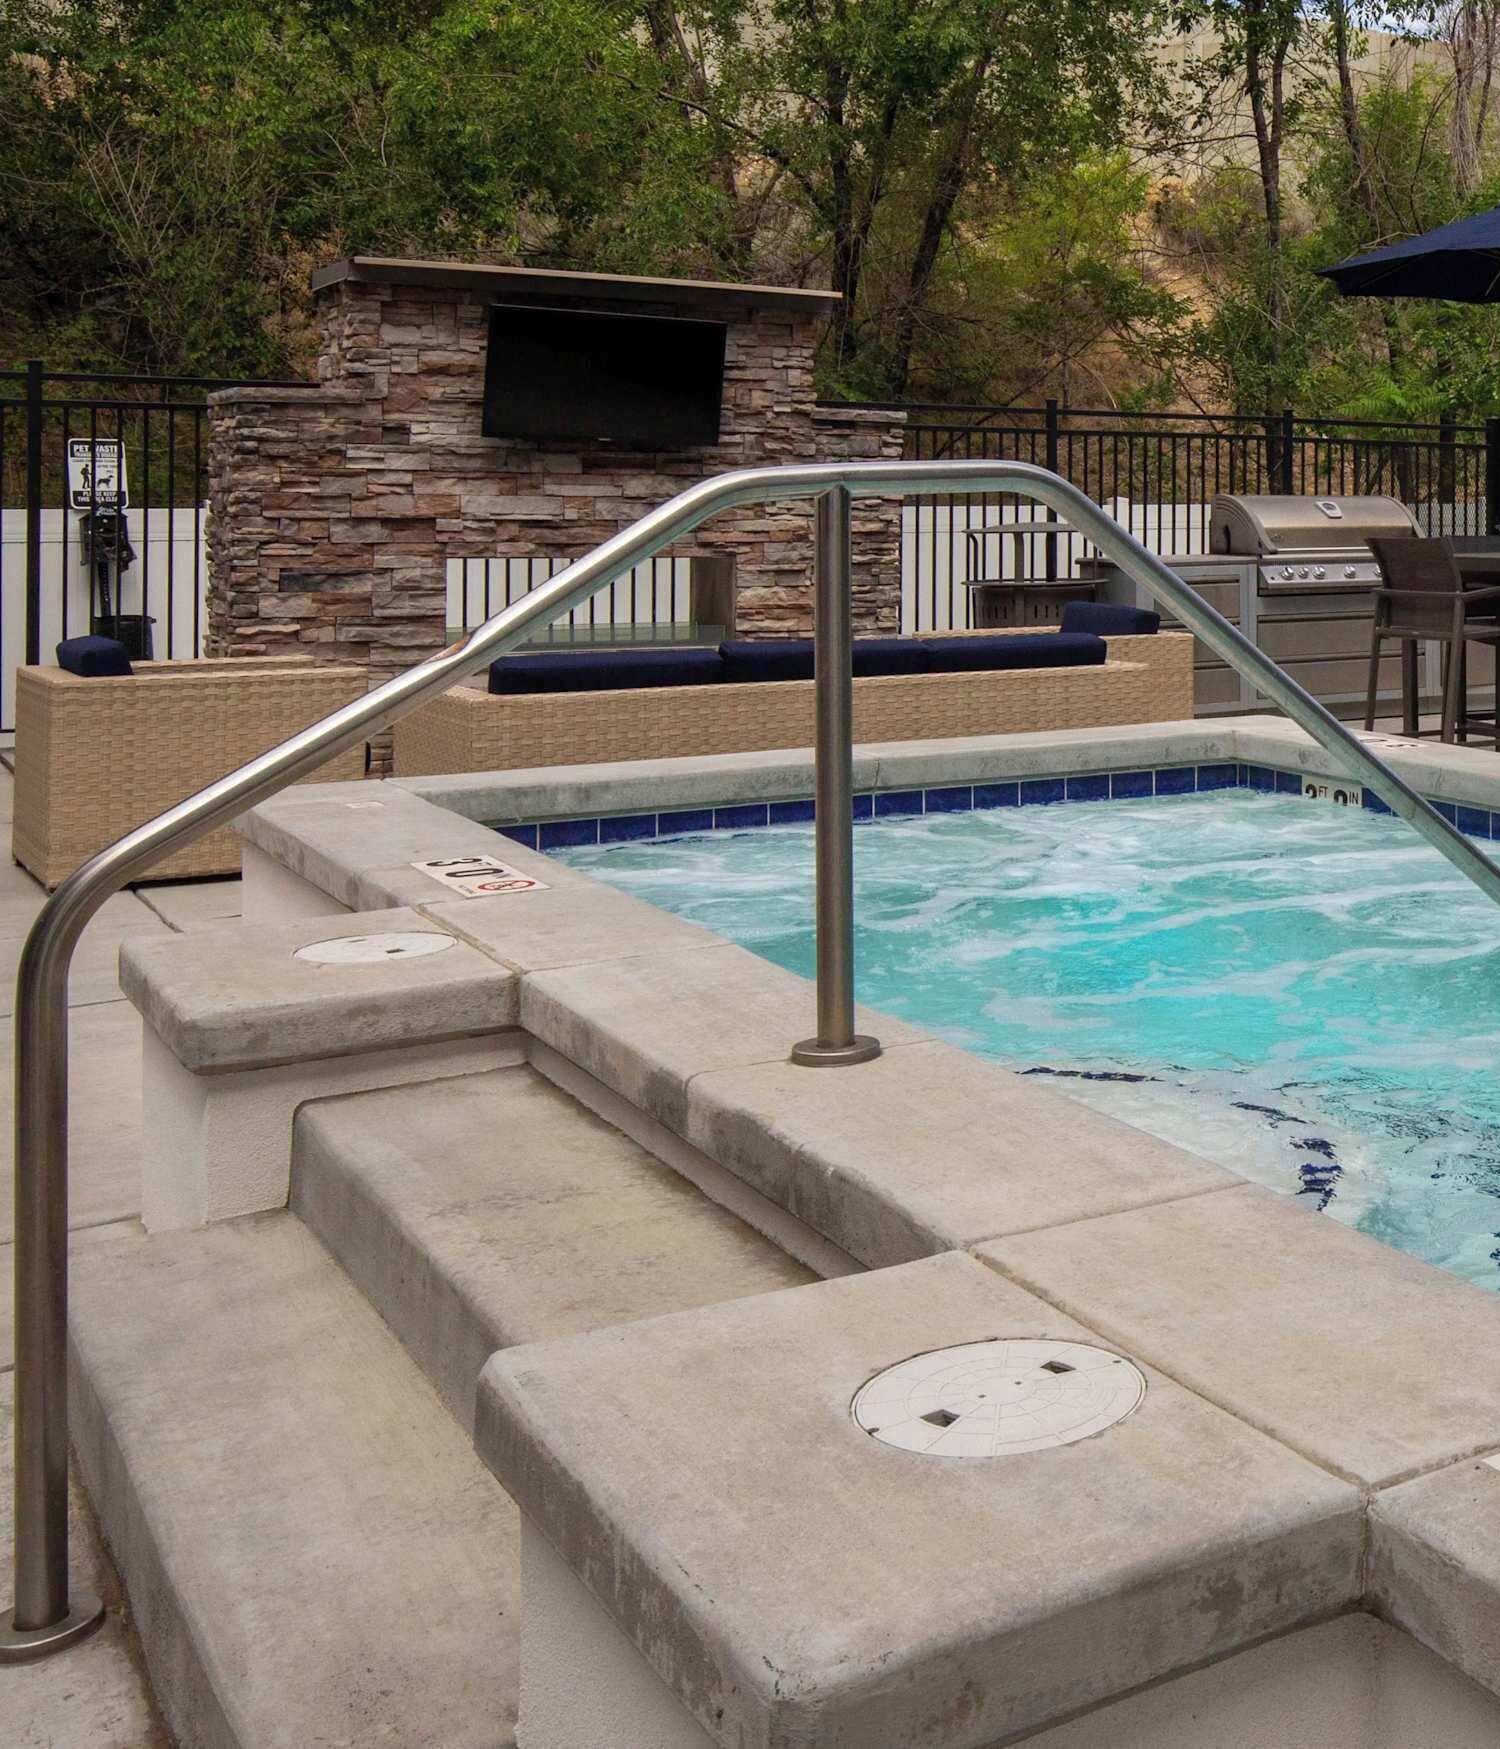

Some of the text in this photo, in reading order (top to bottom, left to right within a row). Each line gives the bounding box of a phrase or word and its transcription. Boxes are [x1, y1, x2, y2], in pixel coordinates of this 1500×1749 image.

[73, 444, 89, 453] PET
[1318, 785, 1328, 798] FT
[1349, 791, 1359, 804] IN
[426, 858, 482, 867] 3
[445, 868, 504, 878] 0
